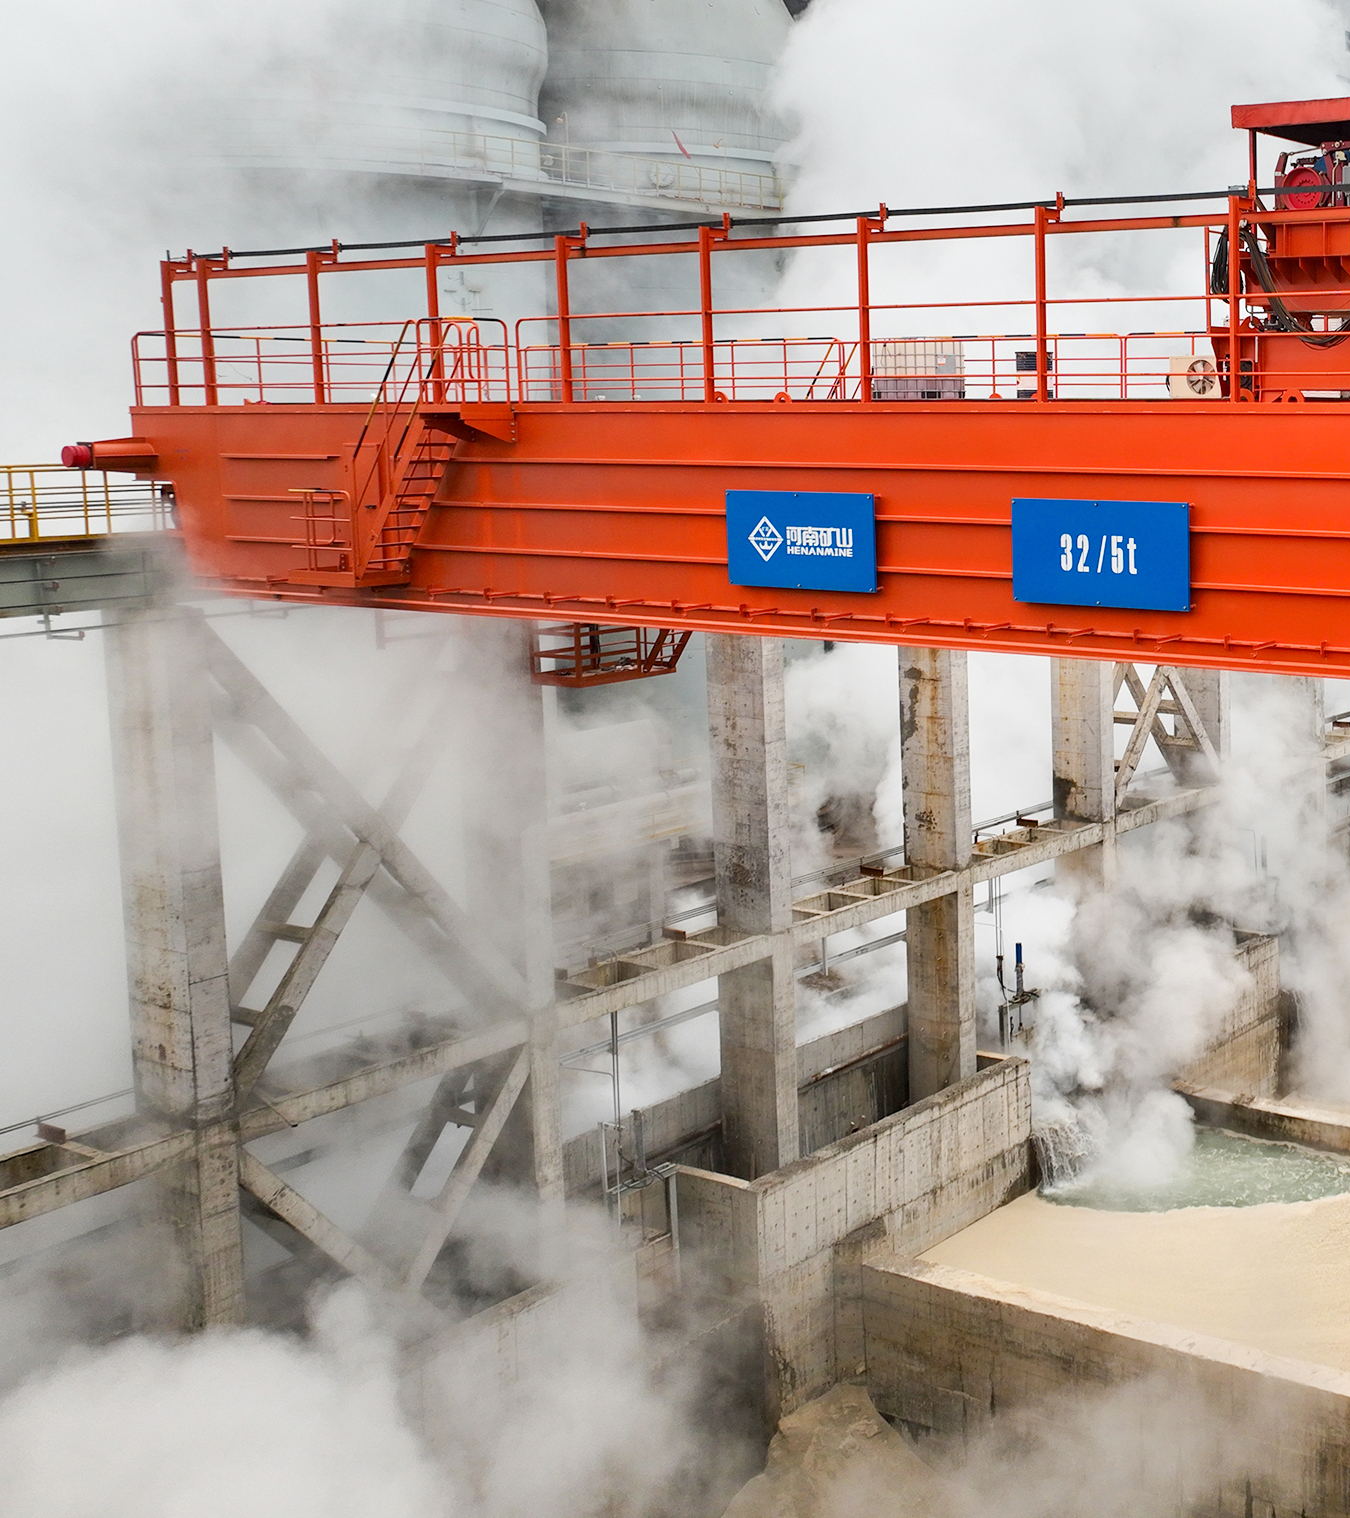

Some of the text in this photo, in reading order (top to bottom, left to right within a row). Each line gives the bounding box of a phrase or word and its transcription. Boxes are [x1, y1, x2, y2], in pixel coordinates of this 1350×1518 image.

[786, 526, 853, 548] 河南矿山
[786, 546, 853, 558] HENANMINE
[1060, 533, 1138, 575] 32/5t
